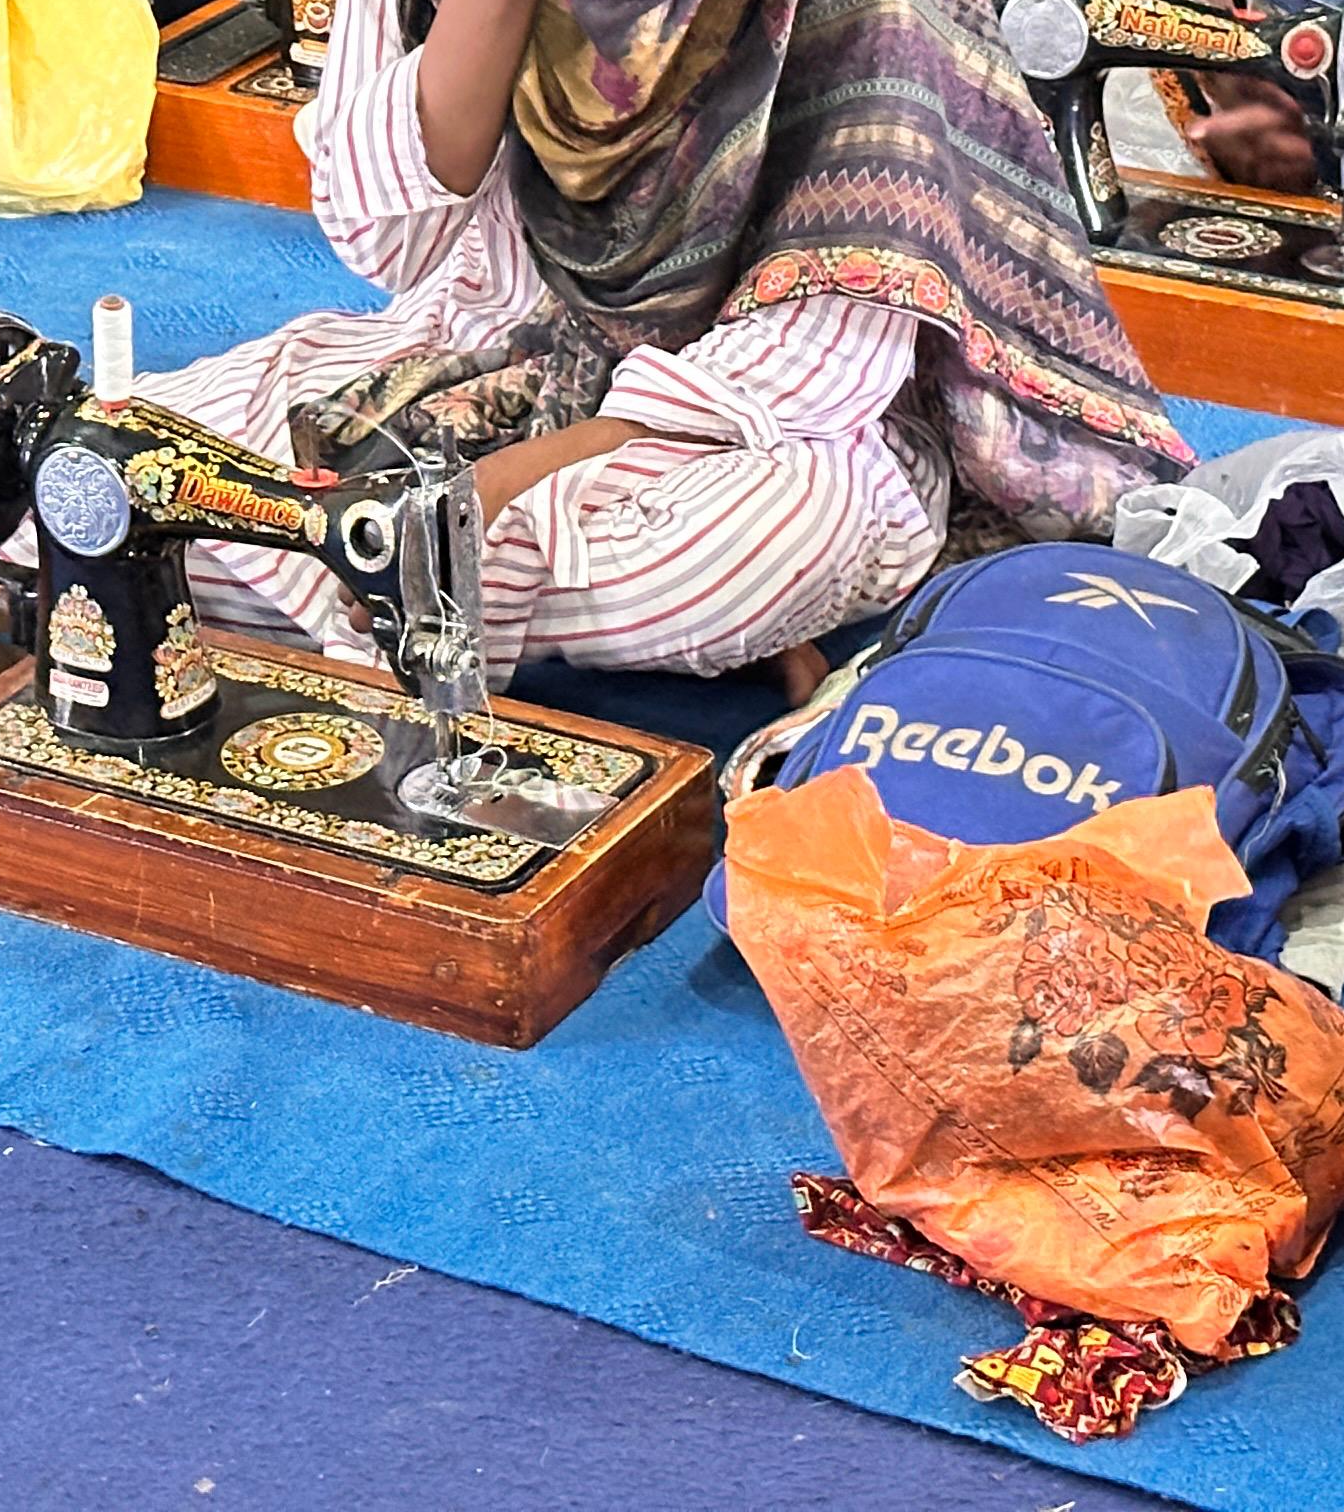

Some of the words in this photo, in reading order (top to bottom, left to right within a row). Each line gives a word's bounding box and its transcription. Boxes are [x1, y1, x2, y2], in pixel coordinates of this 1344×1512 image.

[1120, 6, 1238, 57] National
[176, 471, 304, 530] Dawlance
[838, 703, 1122, 813] Reebok
